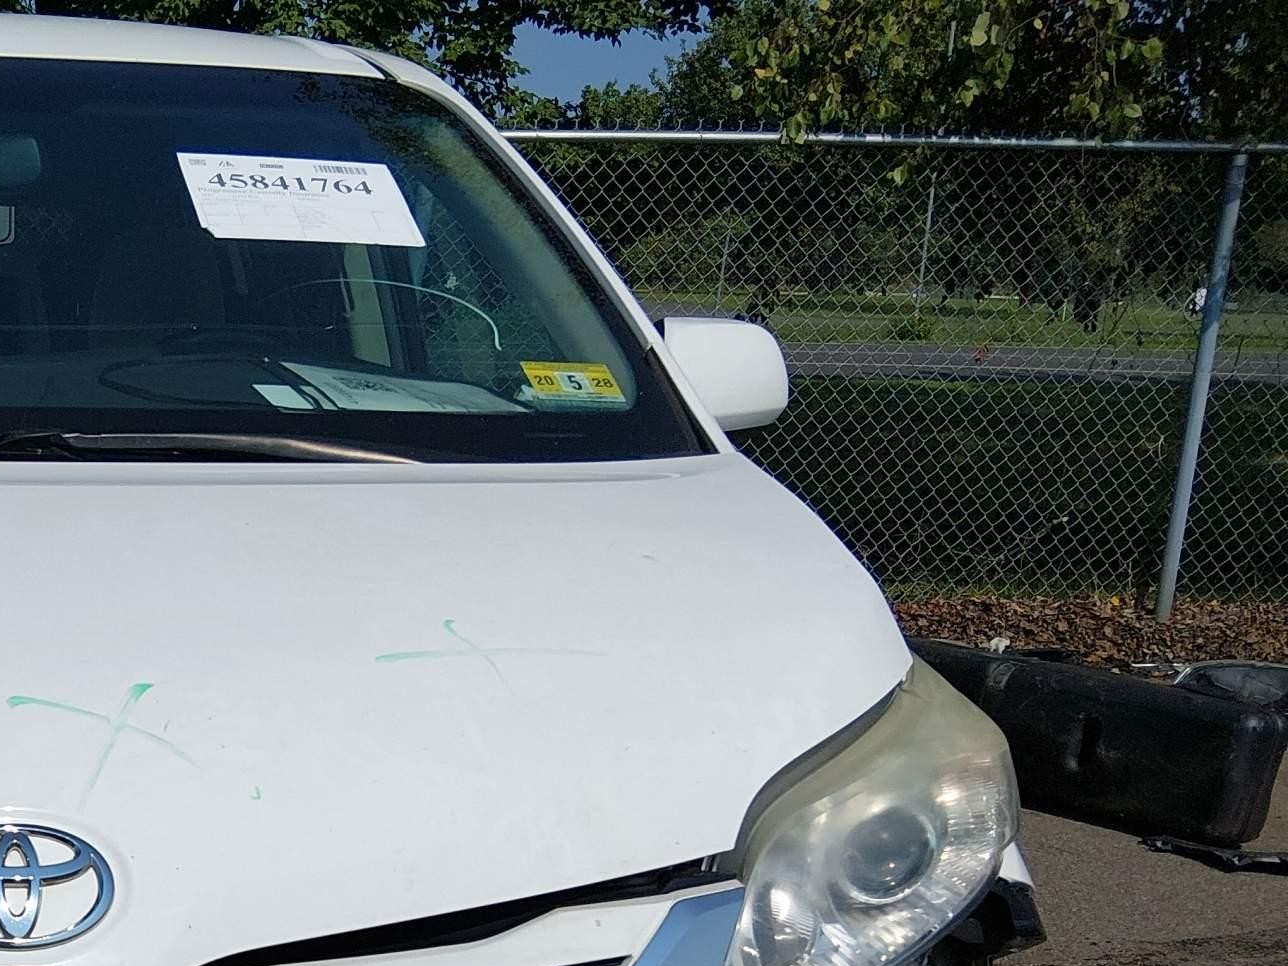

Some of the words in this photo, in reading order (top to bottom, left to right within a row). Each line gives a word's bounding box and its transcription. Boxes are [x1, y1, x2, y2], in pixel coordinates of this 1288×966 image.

[208, 173, 374, 195] 45841764
[534, 375, 555, 386] 20
[565, 375, 583, 391] 5
[592, 377, 614, 388] 28
